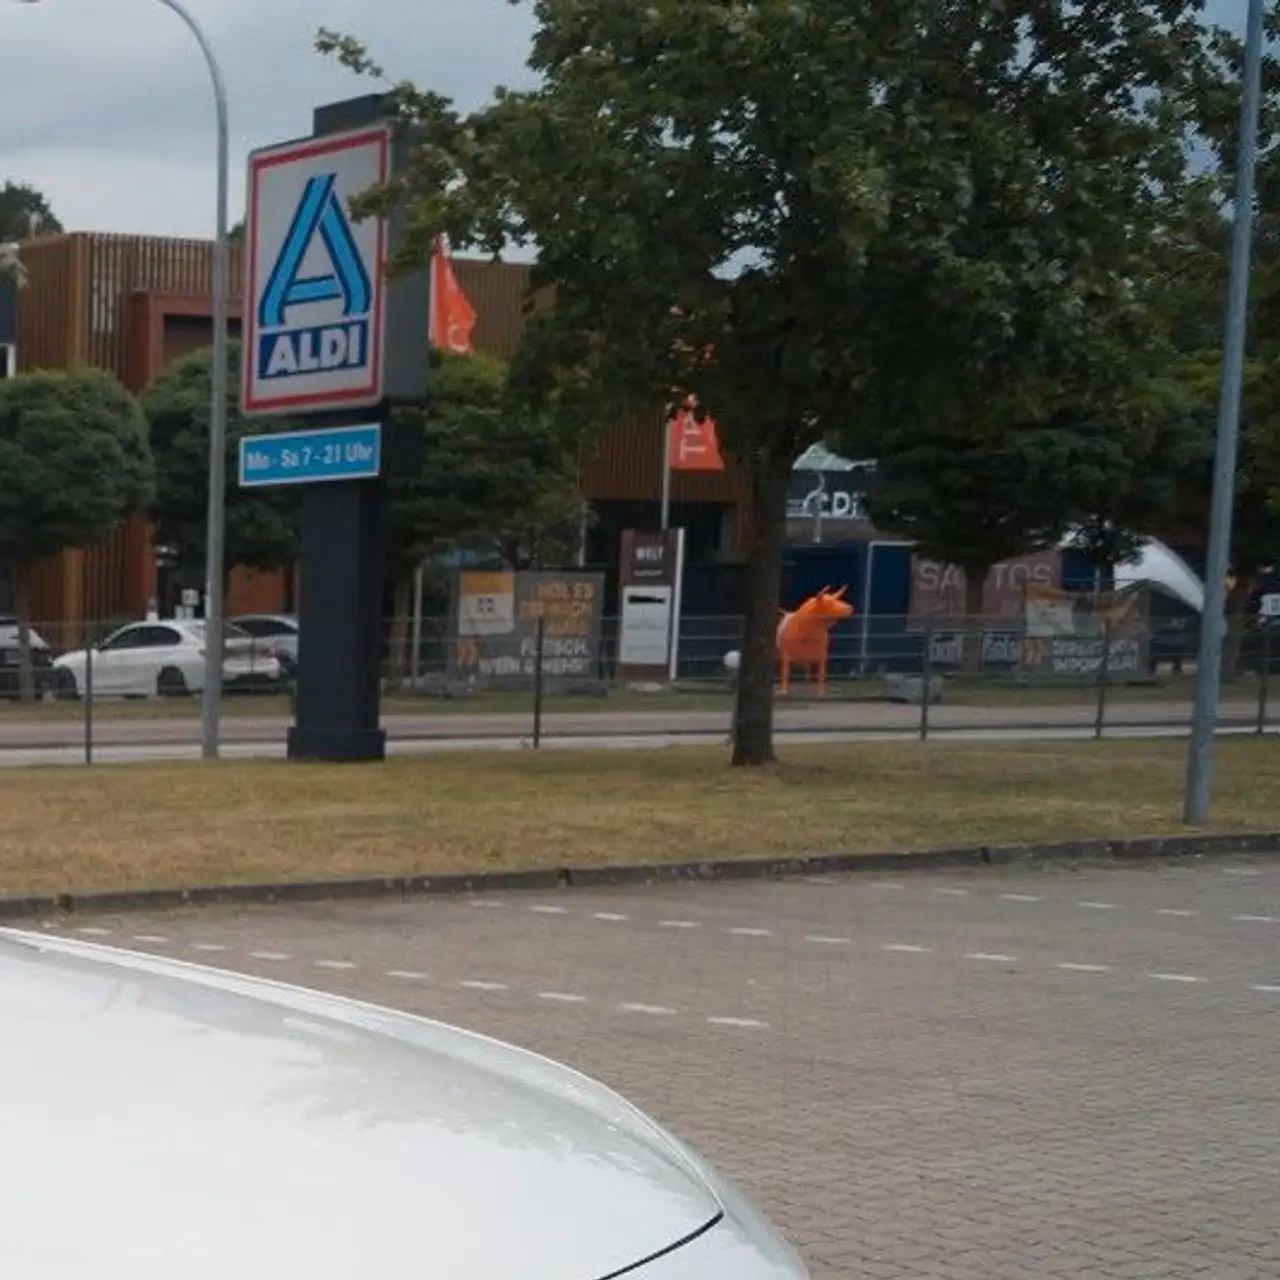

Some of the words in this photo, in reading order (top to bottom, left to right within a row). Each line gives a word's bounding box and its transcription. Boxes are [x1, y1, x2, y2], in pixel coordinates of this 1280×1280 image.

[266, 325, 362, 375] ALDI
[246, 451, 269, 470] Mo
[281, 448, 299, 467] Sa
[344, 441, 373, 462] Uhr
[916, 563, 1052, 590] SATOS
